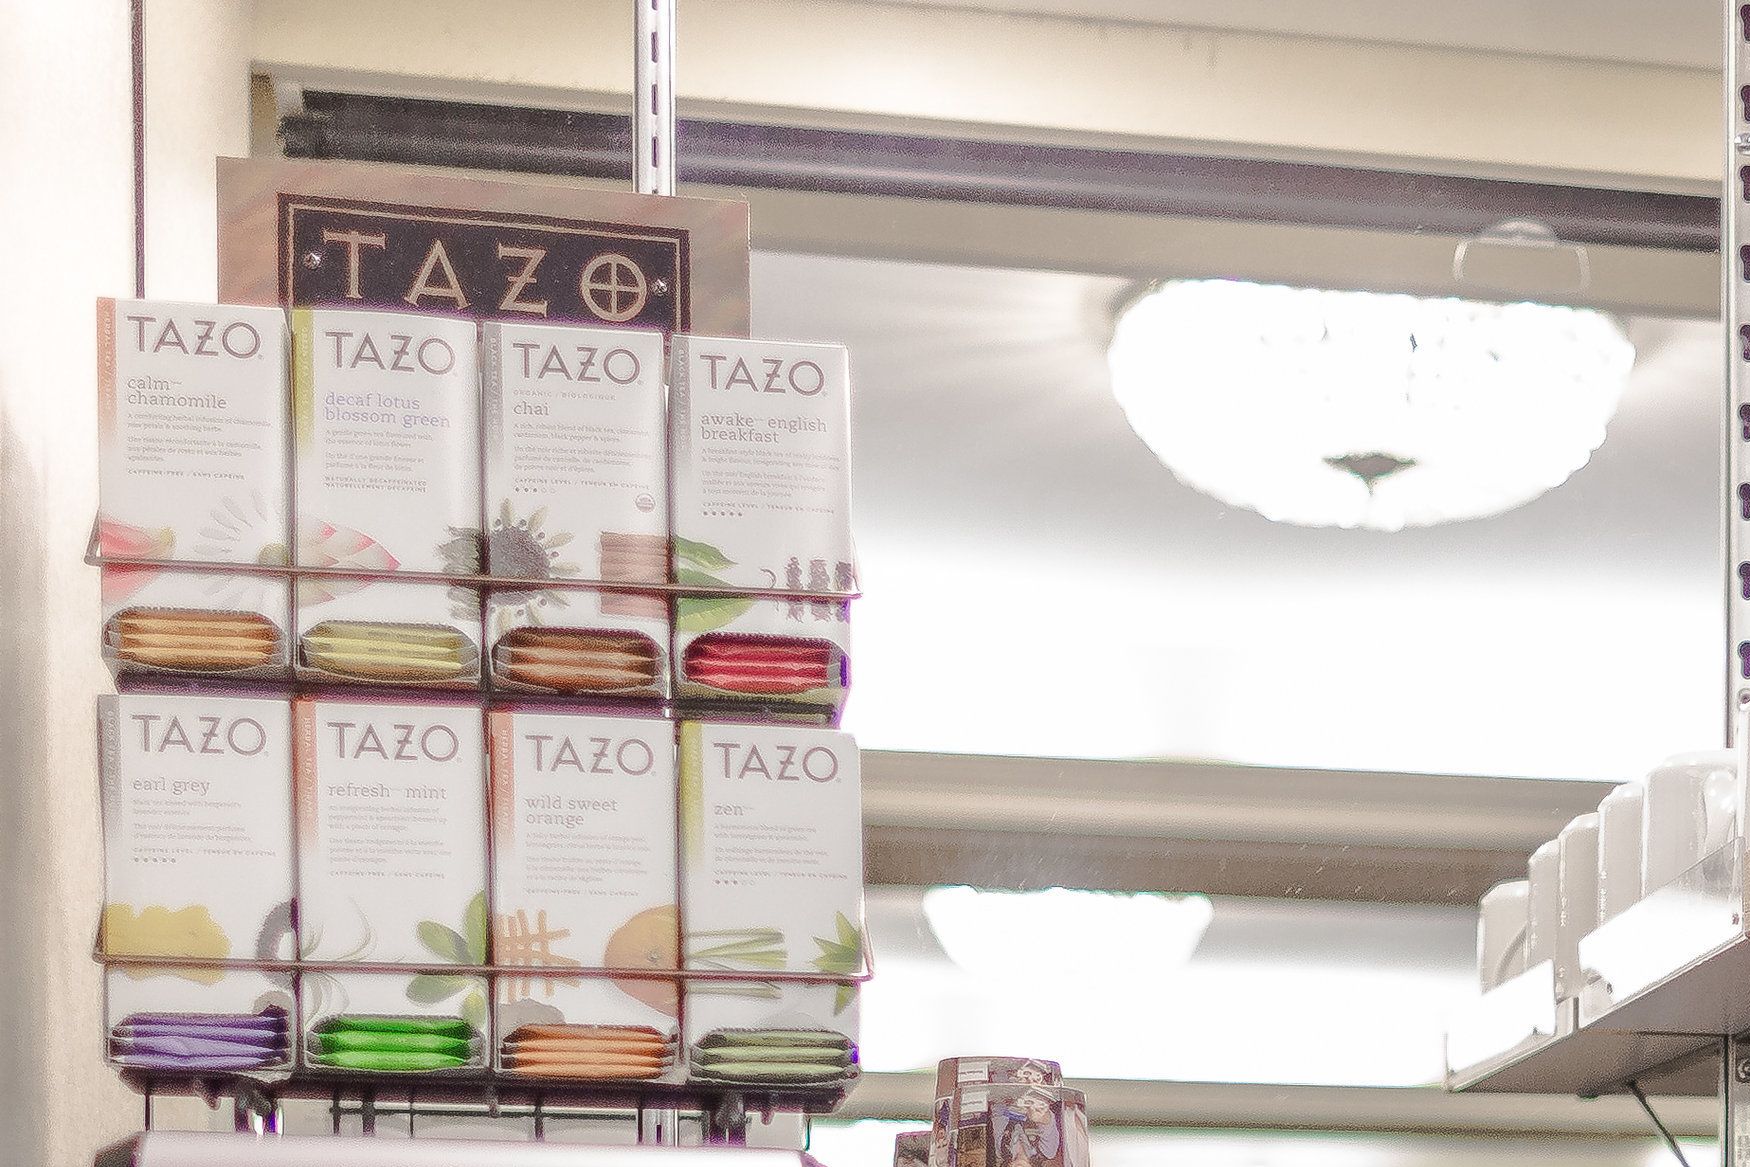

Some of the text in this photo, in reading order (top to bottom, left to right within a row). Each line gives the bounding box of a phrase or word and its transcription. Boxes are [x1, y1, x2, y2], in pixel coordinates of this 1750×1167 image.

[321, 228, 648, 323] TAZO
[127, 315, 261, 359] TAZO
[325, 331, 456, 375] TAZO
[512, 342, 641, 385] TAZO
[127, 376, 170, 391] calm
[699, 354, 825, 397] TAZO
[127, 391, 228, 409] chamomile
[325, 392, 421, 410] decaf lotus
[513, 400, 551, 416] chai
[325, 407, 450, 429] blossom green
[700, 411, 827, 434] awake english
[700, 427, 780, 444] breakfast
[131, 714, 267, 756] TAZO
[326, 721, 460, 762] TAZO
[524, 734, 655, 776] TAZO
[712, 742, 839, 783] TAZO
[133, 777, 210, 796] earl grey
[327, 782, 447, 800] refresh mint
[525, 795, 618, 812] wild sweet
[714, 804, 744, 816] zen
[526, 814, 585, 829] orange
